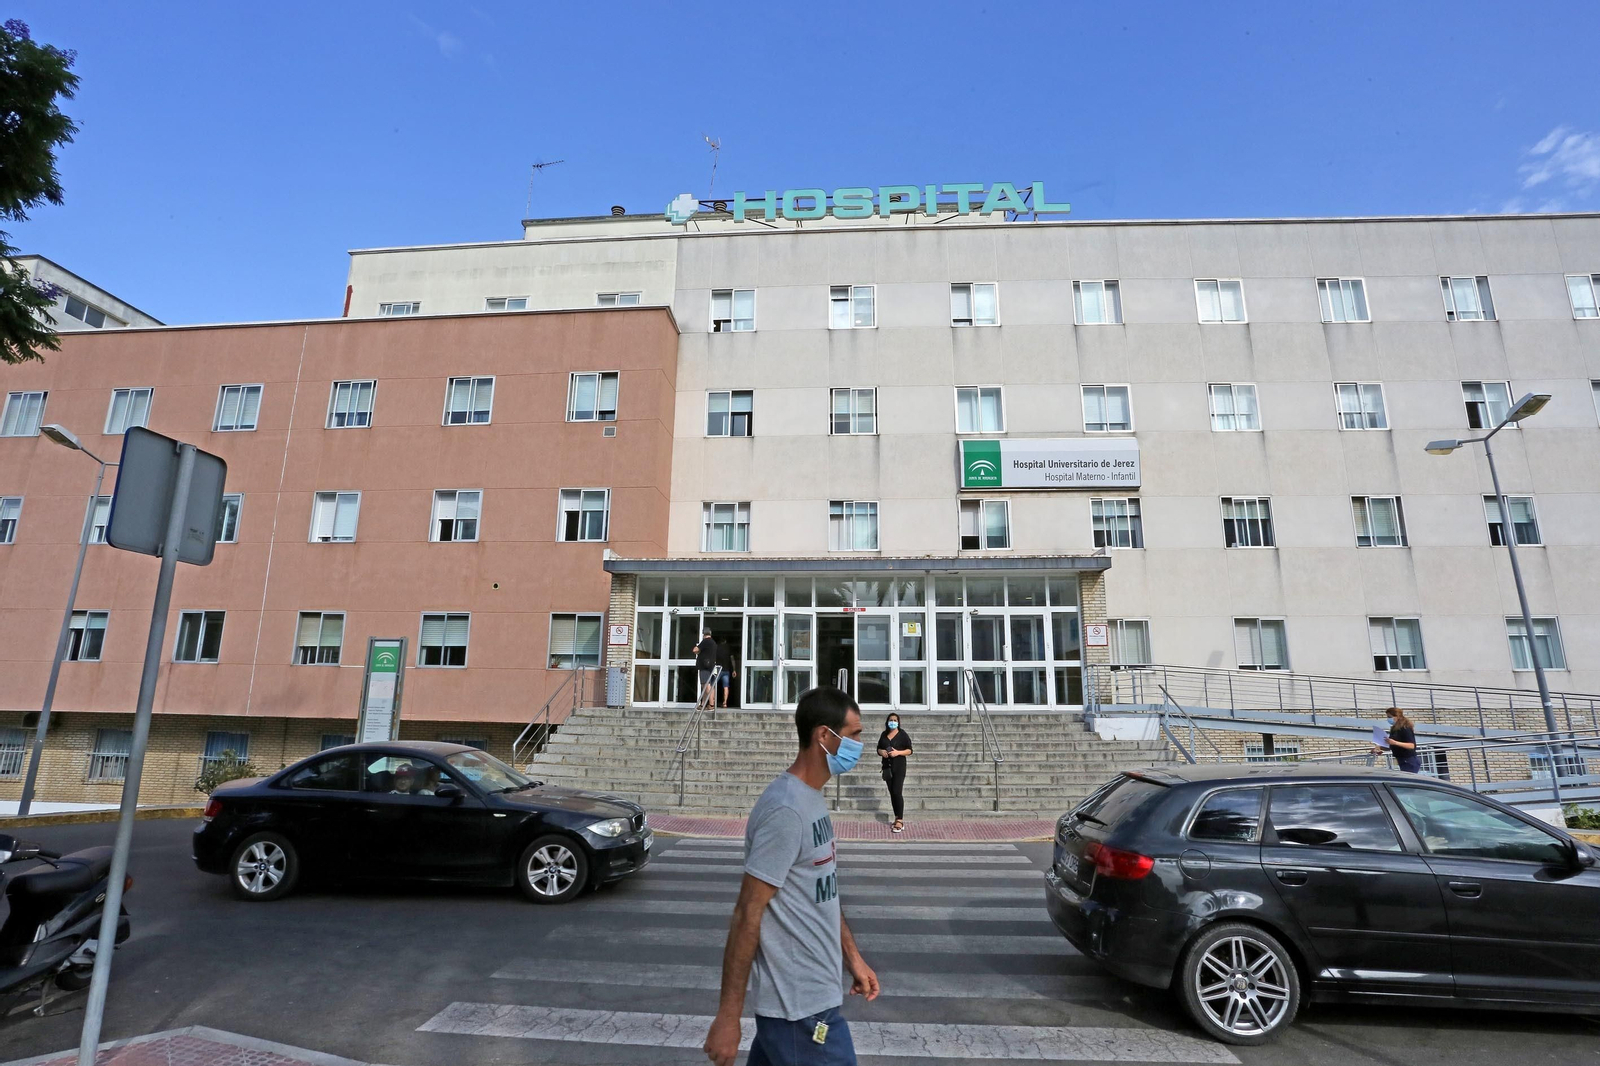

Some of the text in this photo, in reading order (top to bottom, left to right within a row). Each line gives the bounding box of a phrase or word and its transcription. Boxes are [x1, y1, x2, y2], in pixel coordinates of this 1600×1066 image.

[734, 181, 1071, 223] HOSPITAL
[1013, 459, 1135, 470] Hospital Universitario de Jerez
[1044, 472, 1074, 482] Hospital
[1076, 473, 1105, 481] Materno
[1111, 472, 1136, 481] Infantil
